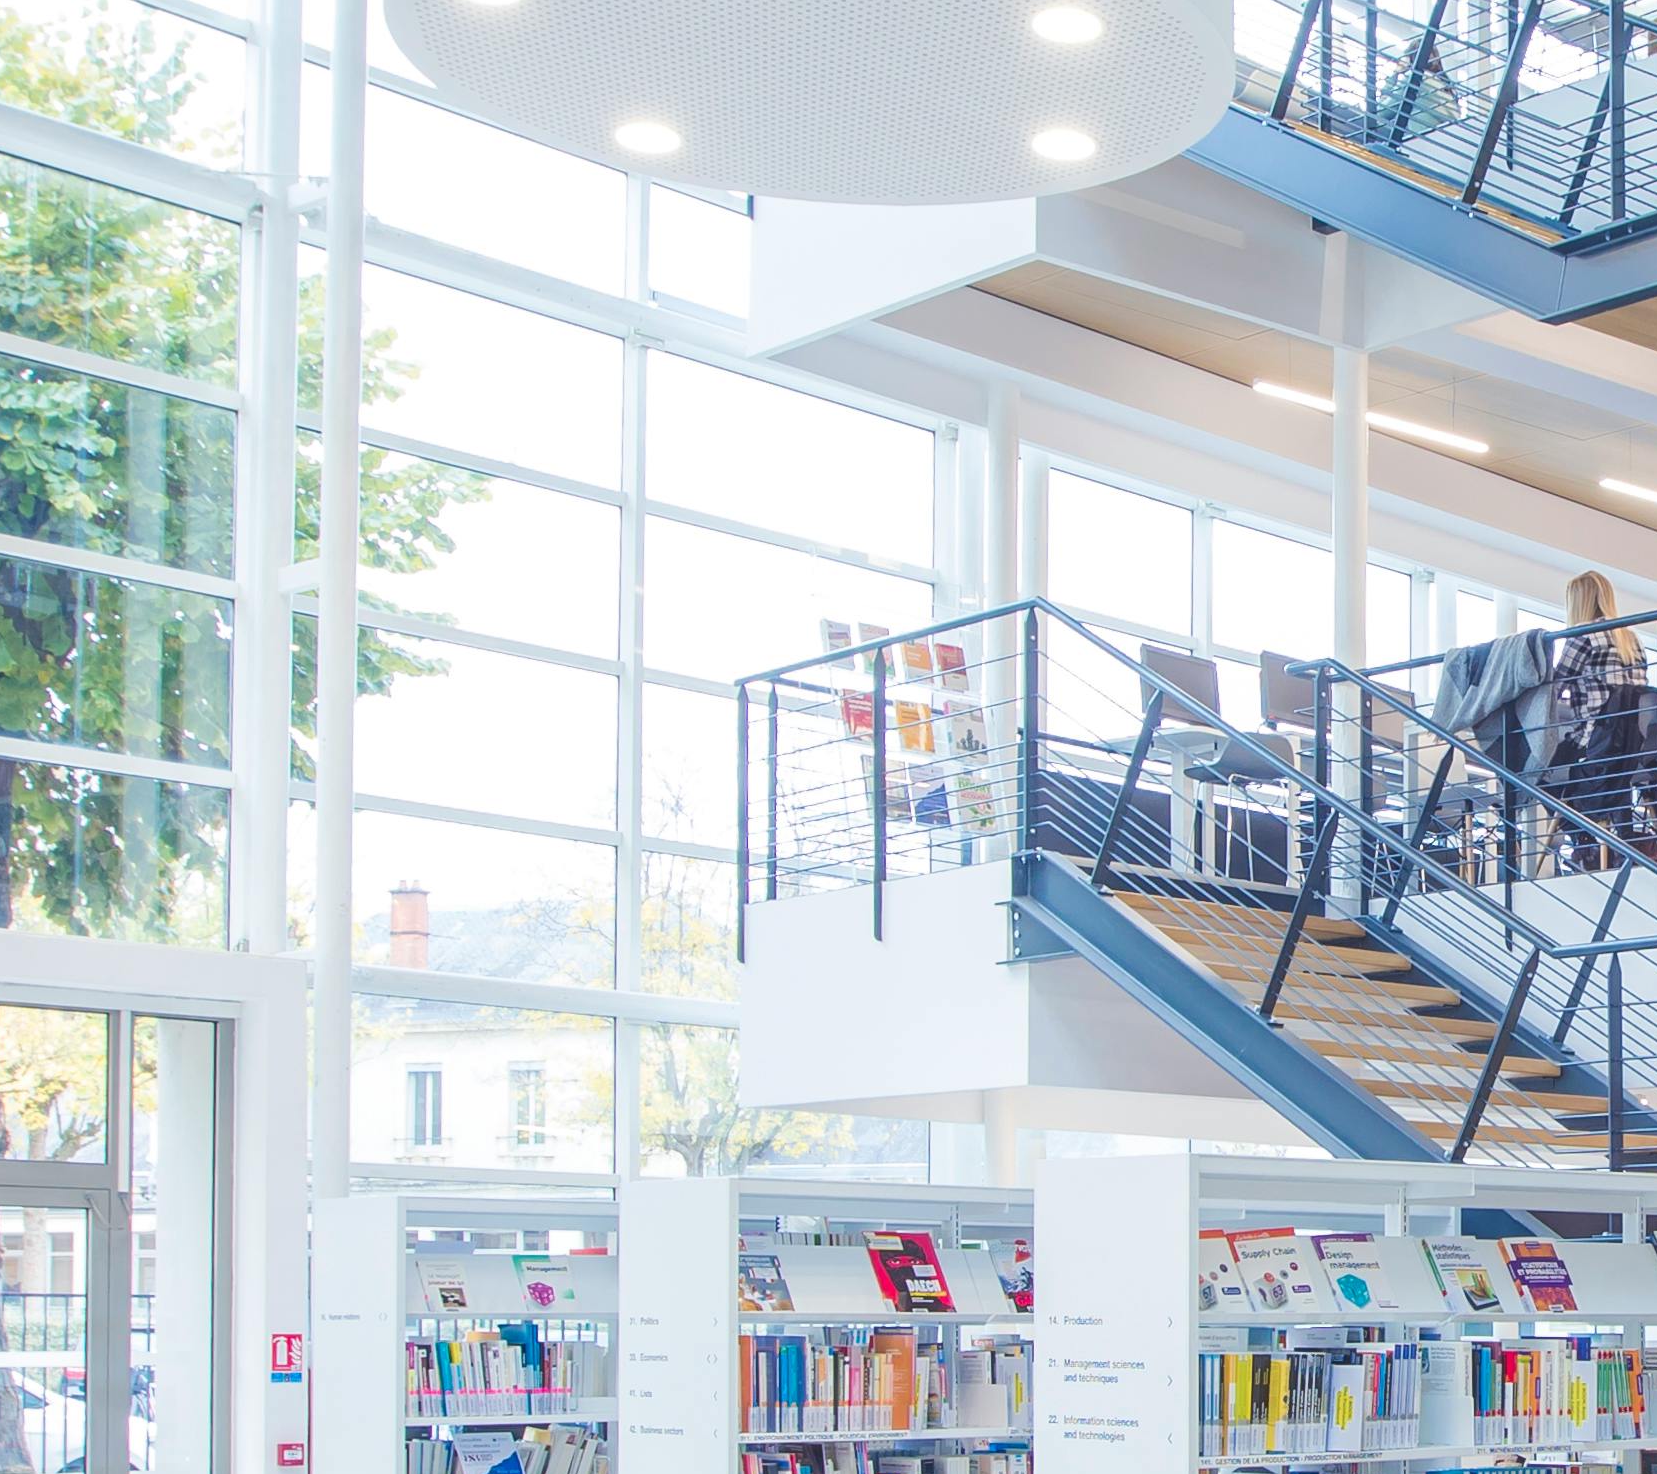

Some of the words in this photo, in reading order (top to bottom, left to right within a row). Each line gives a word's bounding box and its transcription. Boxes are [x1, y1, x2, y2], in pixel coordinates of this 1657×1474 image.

[1242, 1247, 1271, 1259] Supply
[1273, 1247, 1296, 1256] Chain
[1325, 1251, 1354, 1261] Design
[1330, 1261, 1380, 1270] management
[905, 1279, 942, 1293] DAECH
[1064, 1316, 1103, 1326] Production
[1064, 1359, 1111, 1371] Management
[1112, 1360, 1145, 1370] sciences
[1064, 1373, 1077, 1382] and
[1078, 1374, 1119, 1386] techniques
[1048, 1415, 1059, 1425] 22.
[1064, 1415, 1105, 1426] Information
[1106, 1417, 1139, 1428] sciences
[1064, 1431, 1077, 1440] and
[1078, 1431, 1125, 1444] technologies
[1261, 1455, 1299, 1463] PRODUCTION
[1304, 1453, 1342, 1462] PRODUCTION
[1343, 1452, 1383, 1460] MANAGEMENT
